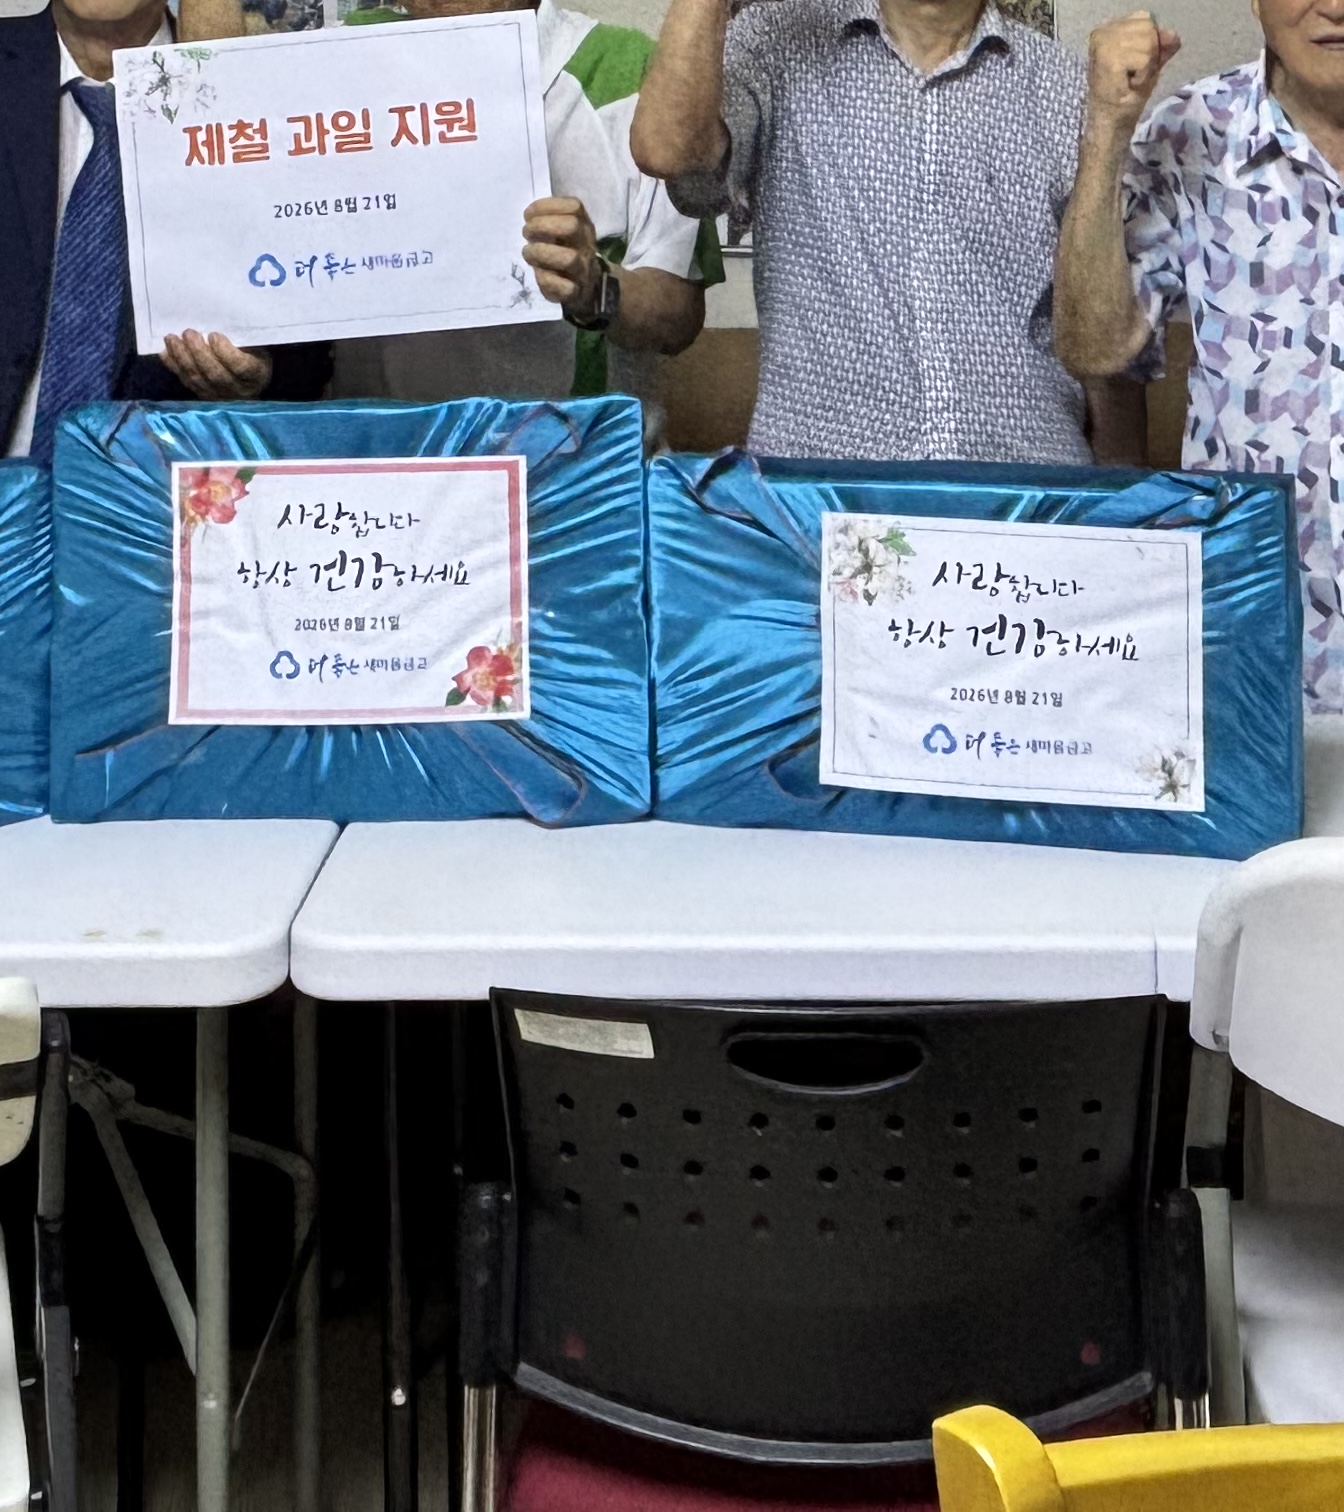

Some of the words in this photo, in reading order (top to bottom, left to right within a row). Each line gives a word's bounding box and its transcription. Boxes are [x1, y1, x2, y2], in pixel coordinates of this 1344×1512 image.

[182, 118, 270, 166] 제철
[287, 108, 374, 156] 과일
[388, 98, 478, 147] 지원
[273, 200, 328, 218] 2026년
[334, 196, 357, 213] 8월
[362, 193, 397, 210] 21일
[294, 255, 318, 288] 더
[277, 501, 420, 538] 사랑합니다
[237, 560, 297, 589] 항상
[310, 550, 470, 592] 건강하세요
[932, 561, 1085, 603] 사랑합니다
[369, 614, 401, 631] 21일
[888, 618, 955, 649] 항상
[966, 613, 1139, 662] 건강하세요
[308, 654, 329, 683] 더
[950, 687, 1000, 705] 2026년
[1032, 691, 1063, 708] 21일
[965, 731, 987, 760] 더
